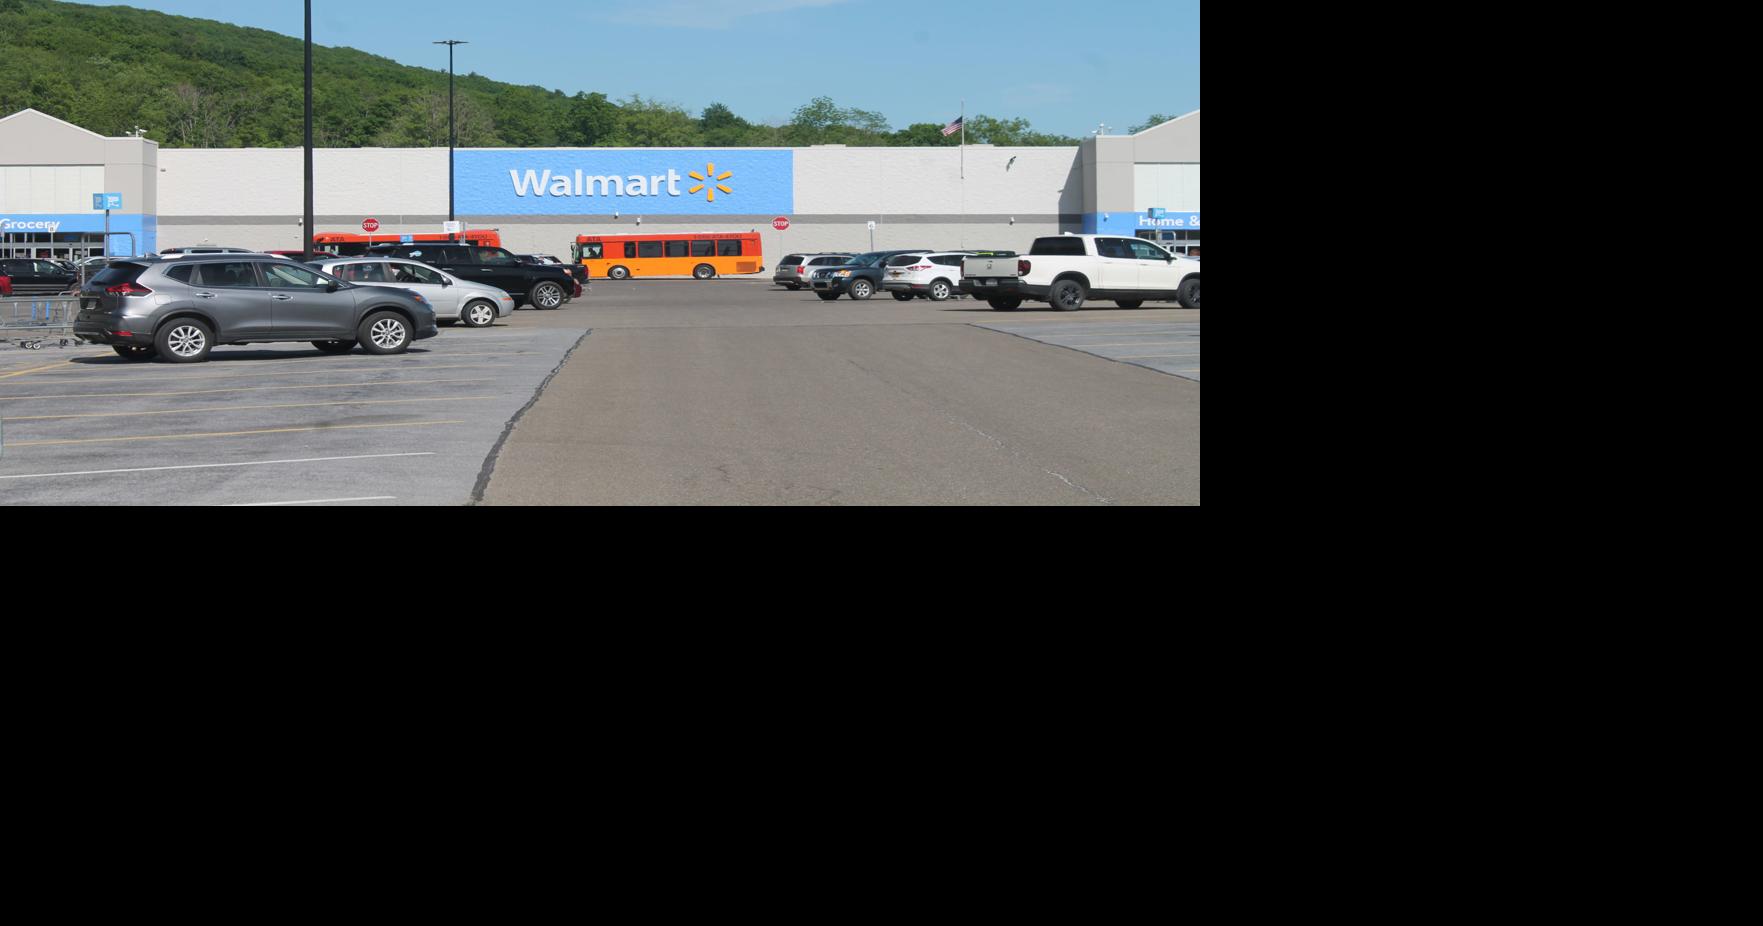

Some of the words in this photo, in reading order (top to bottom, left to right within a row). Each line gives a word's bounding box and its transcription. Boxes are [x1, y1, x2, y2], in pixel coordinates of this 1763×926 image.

[509, 169, 681, 196] Walmart
[0, 218, 60, 231] Grocery
[1139, 215, 1184, 226] Home
[1189, 215, 1200, 226] &
